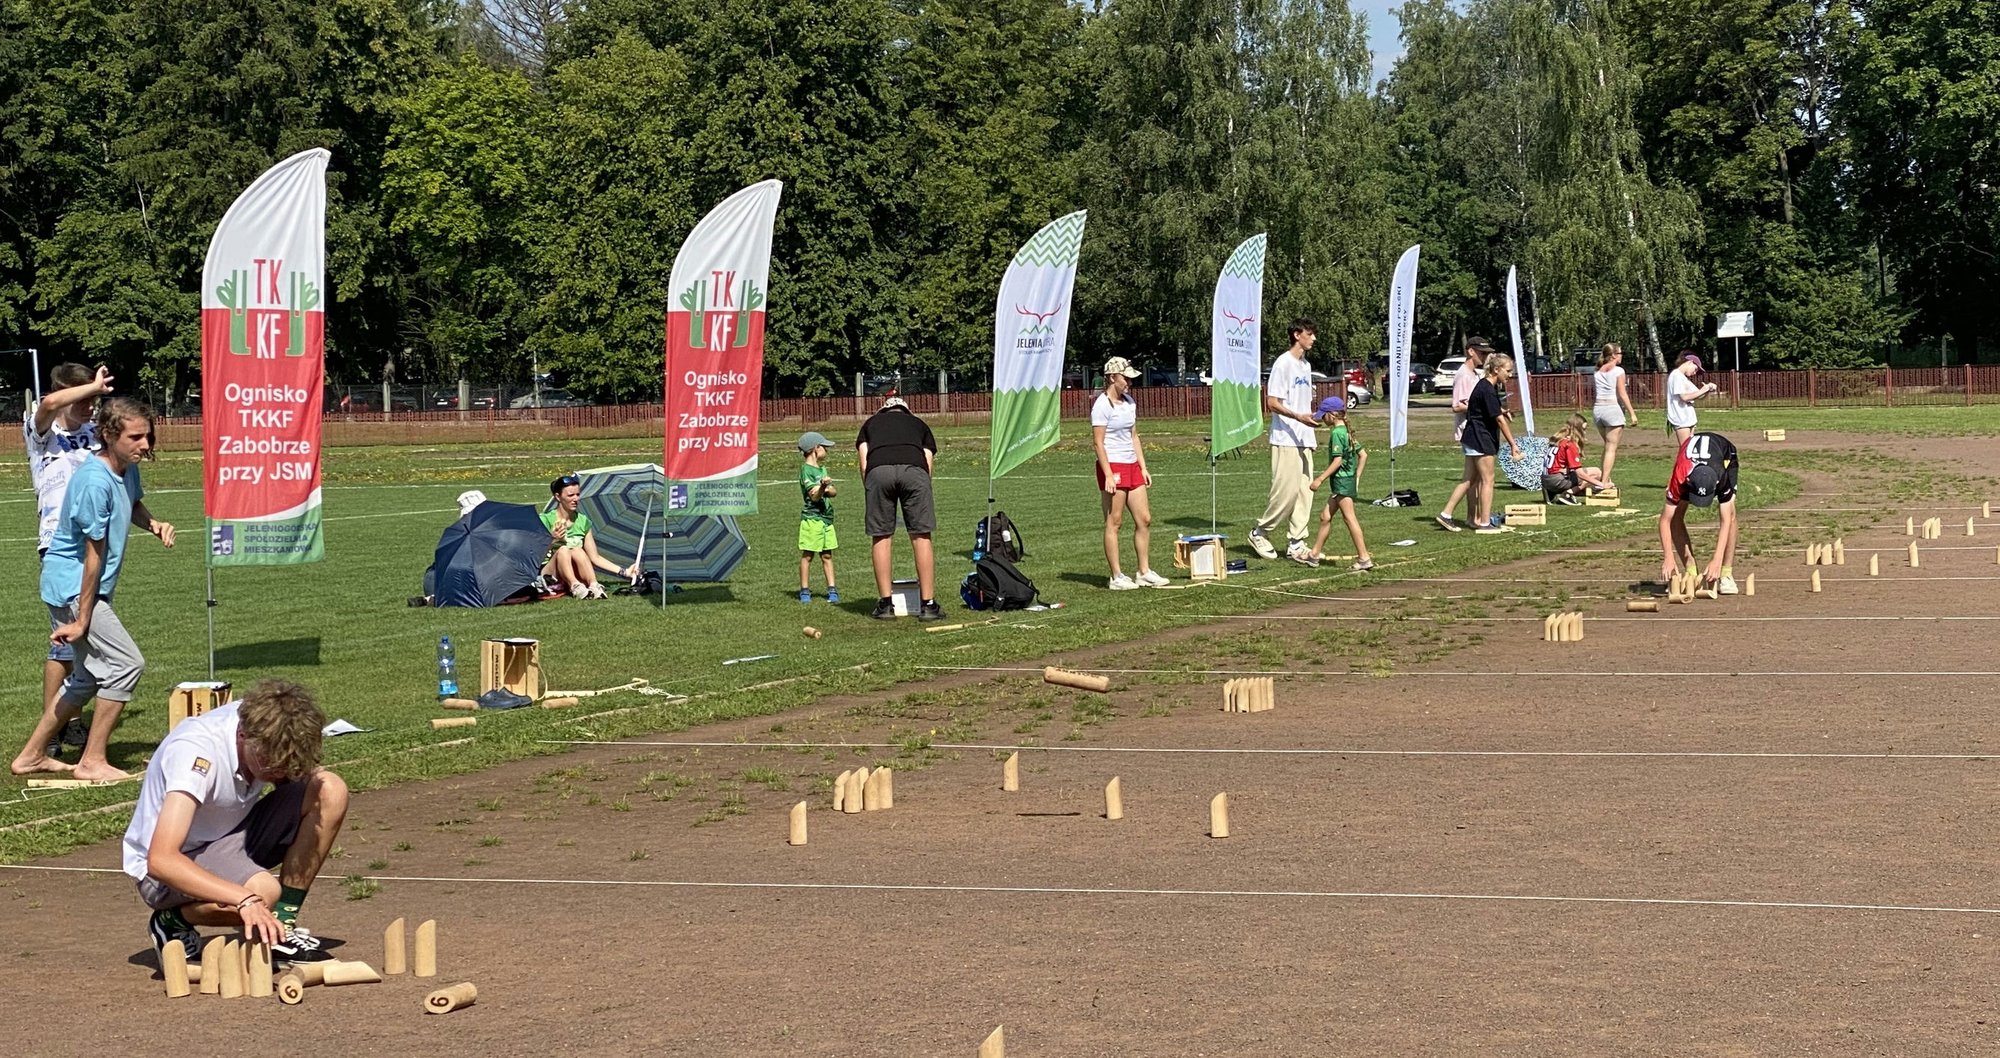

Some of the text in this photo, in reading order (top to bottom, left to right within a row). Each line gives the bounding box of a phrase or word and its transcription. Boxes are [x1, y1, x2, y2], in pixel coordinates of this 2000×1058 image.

[253, 259, 283, 305] TK
[711, 271, 737, 307] TK
[256, 313, 281, 360] KF
[710, 314, 733, 352] KF
[684, 370, 748, 390] Ognisko
[224, 383, 308, 406] Ognisko
[693, 391, 735, 406] TKKF
[237, 409, 293, 428] TKKF
[678, 412, 749, 428] Zabobrze
[218, 436, 311, 454] Zabobrze
[678, 432, 748, 453] przy JSM
[219, 461, 312, 485] przy JSM
